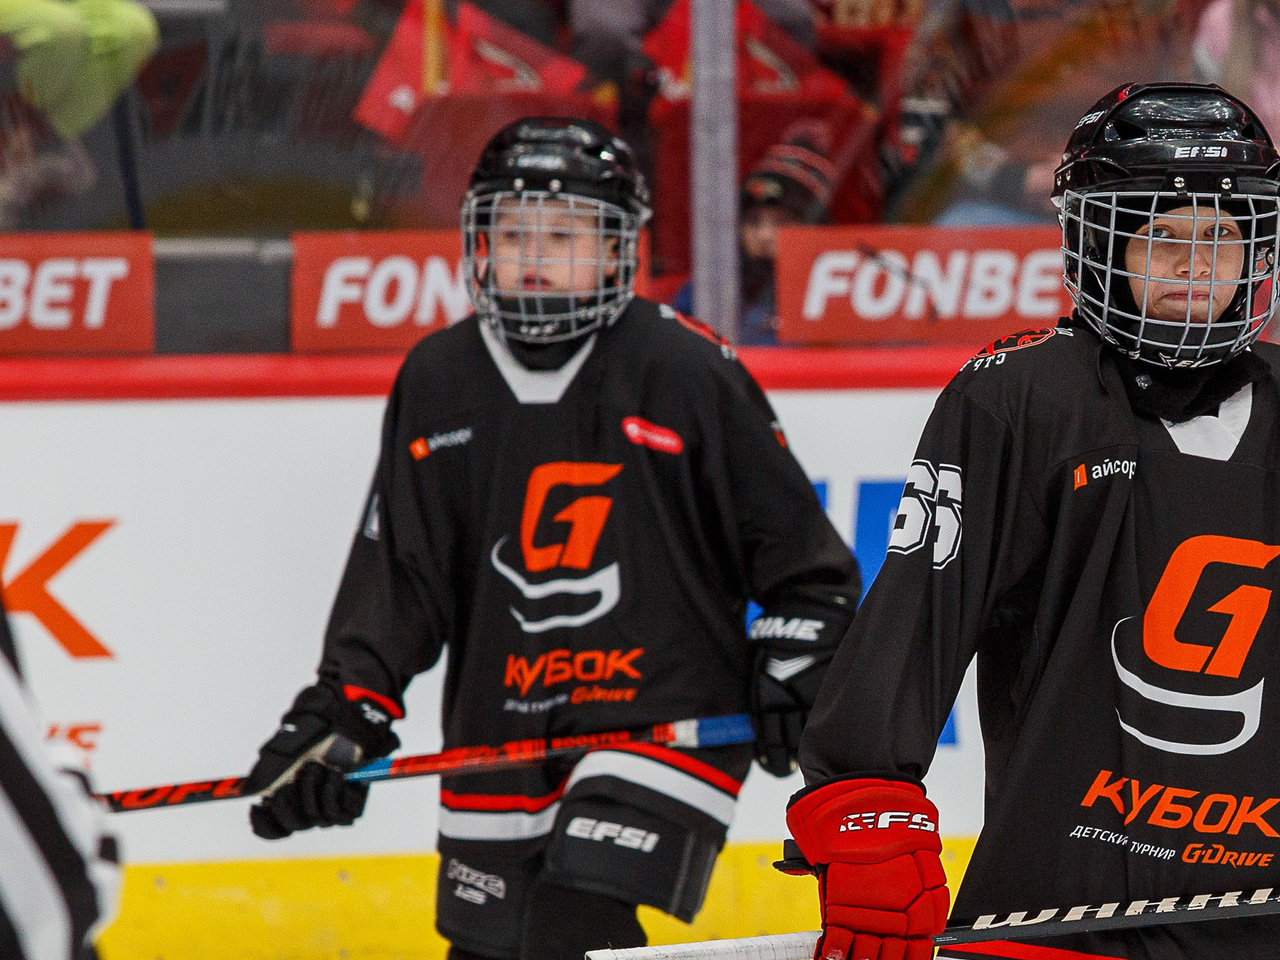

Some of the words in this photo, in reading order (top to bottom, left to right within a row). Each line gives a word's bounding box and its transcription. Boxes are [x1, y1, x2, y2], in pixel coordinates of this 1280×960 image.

[503, 647, 645, 697] КУБОК
[565, 816, 659, 853] EFSI
[1130, 841, 1176, 861] ТУРНИР
